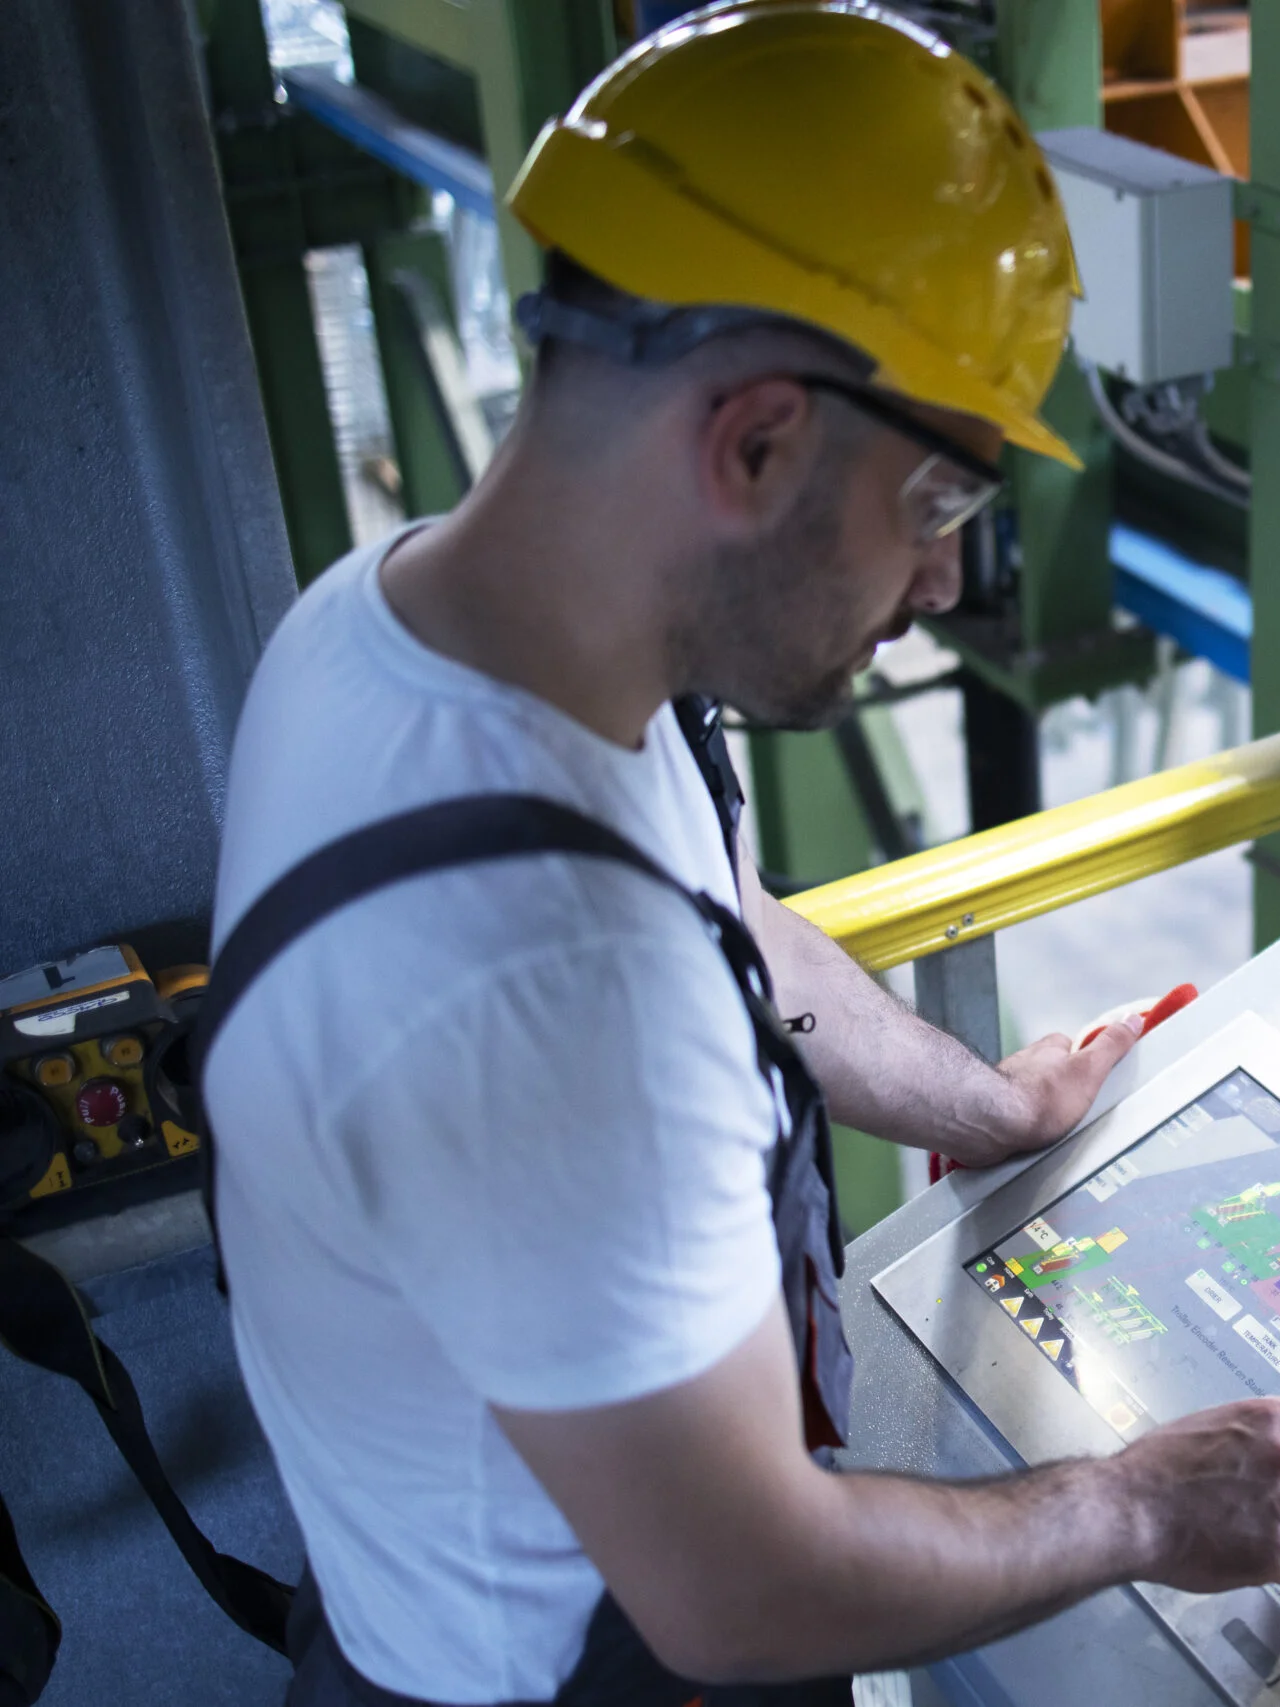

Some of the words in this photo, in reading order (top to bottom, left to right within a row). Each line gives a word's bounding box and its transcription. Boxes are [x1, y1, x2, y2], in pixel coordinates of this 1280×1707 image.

[1204, 1287, 1222, 1303] DRIER
[1167, 1304, 1194, 1329] Trolley
[1189, 1325, 1220, 1353] Encoder
[1215, 1350, 1239, 1371] Reset
[1242, 1330, 1280, 1366] TEMPERATURE
[1262, 1335, 1277, 1349] TANK
